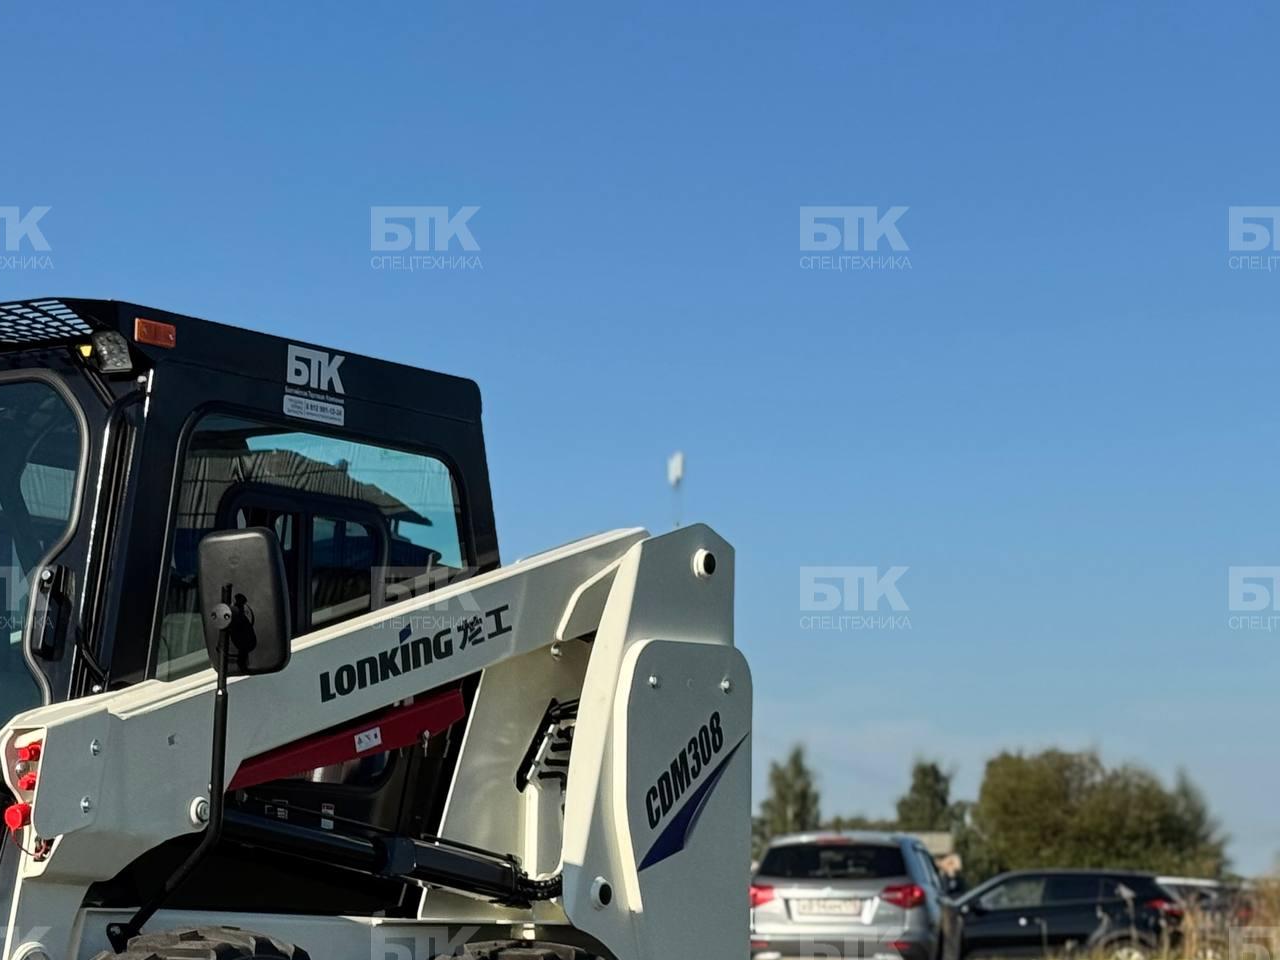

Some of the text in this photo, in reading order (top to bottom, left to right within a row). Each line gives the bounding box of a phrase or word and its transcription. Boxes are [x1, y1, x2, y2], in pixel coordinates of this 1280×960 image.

[287, 344, 346, 394] БТК
[320, 623, 454, 704] LONKING
[645, 711, 724, 830] CDM308
